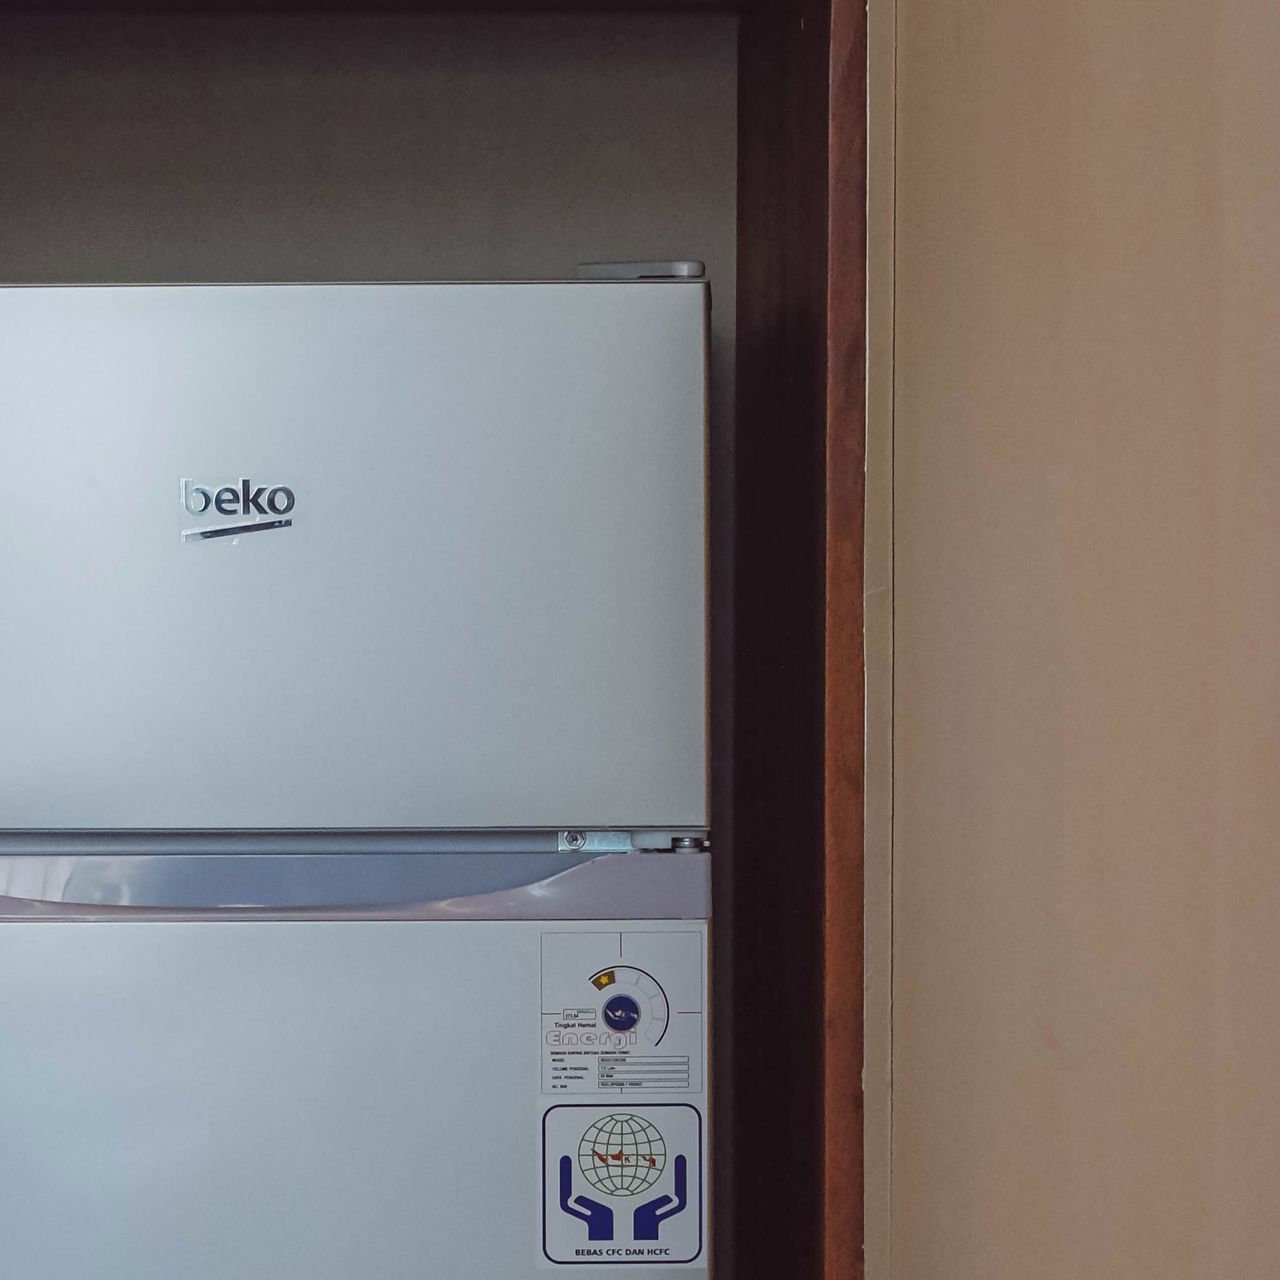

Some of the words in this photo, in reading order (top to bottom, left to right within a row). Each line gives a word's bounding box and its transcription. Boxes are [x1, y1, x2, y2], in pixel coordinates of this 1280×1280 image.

[181, 478, 296, 516] beko
[546, 1029, 638, 1050] Energi
[575, 1248, 603, 1256] BEBAS
[605, 1248, 623, 1256] CFC
[625, 1248, 645, 1256] DAN
[647, 1247, 670, 1256] HCFC
